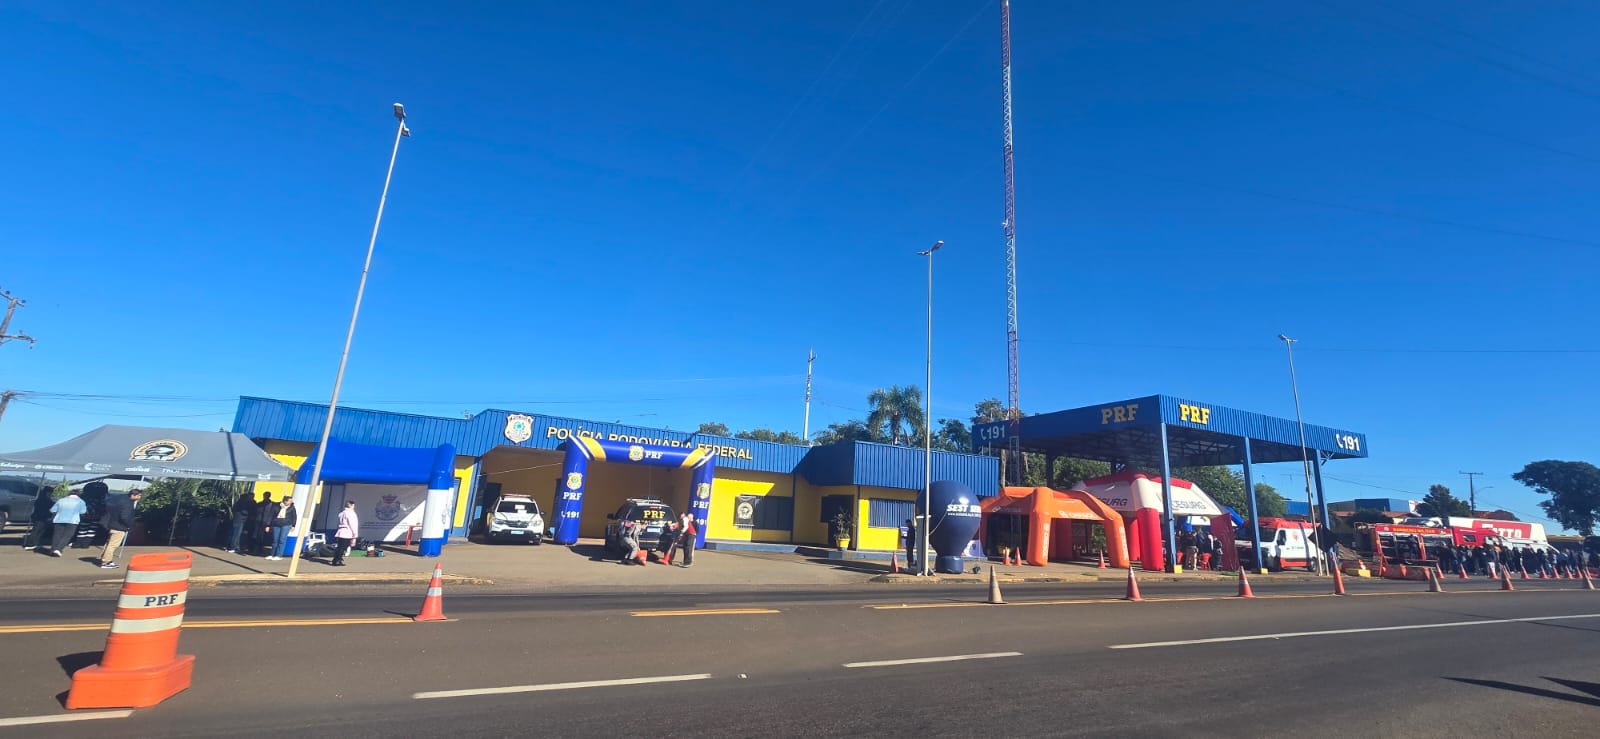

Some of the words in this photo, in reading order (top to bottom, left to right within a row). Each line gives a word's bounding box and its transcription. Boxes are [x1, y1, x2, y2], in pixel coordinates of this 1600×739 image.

[1101, 404, 1139, 424] PRF
[1180, 403, 1210, 425] PRF
[987, 425, 1006, 440] 191
[1342, 434, 1360, 451] 191
[644, 450, 664, 459] PRF
[563, 491, 583, 501] PRF
[693, 500, 710, 509] PRF
[946, 504, 969, 513] SEST
[566, 510, 580, 519] 191
[643, 510, 666, 519] PRF
[144, 594, 178, 607] PRF
